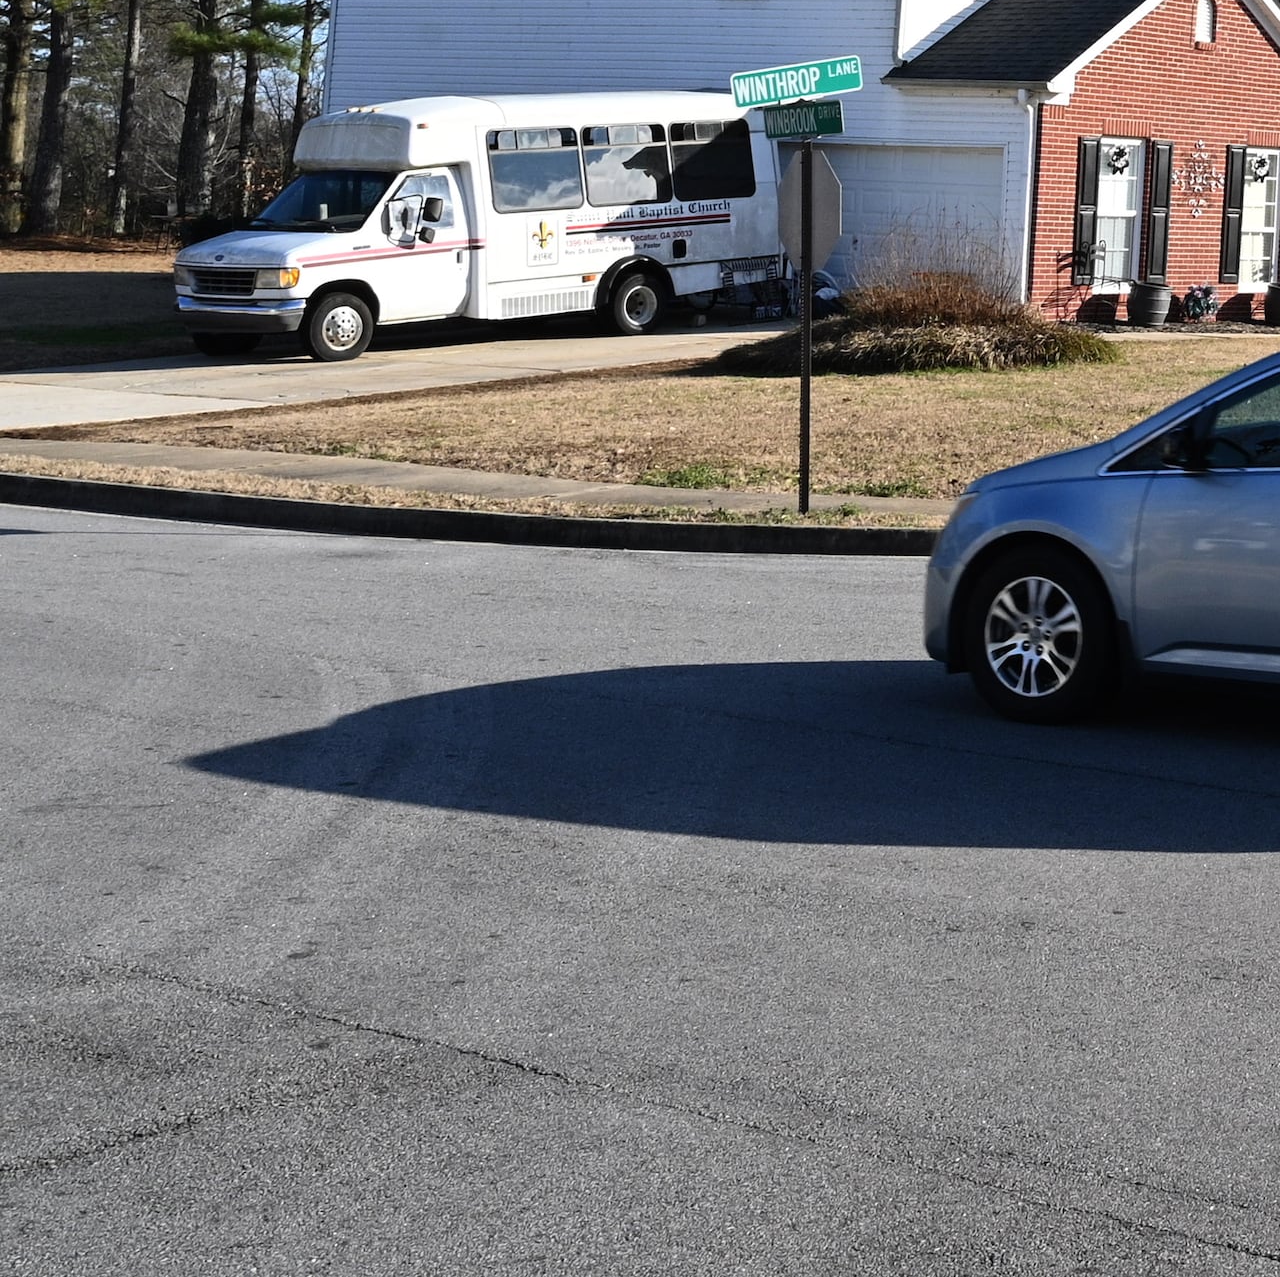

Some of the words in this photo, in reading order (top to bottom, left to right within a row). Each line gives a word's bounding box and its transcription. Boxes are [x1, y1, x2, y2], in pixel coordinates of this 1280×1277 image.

[734, 66, 820, 104] WINTHROP
[827, 60, 859, 78] LANE
[765, 107, 817, 135] WINBROOK
[818, 104, 841, 119] DRIVE
[638, 204, 685, 220] Baptist
[688, 199, 731, 215] Church
[660, 231, 671, 240] GA
